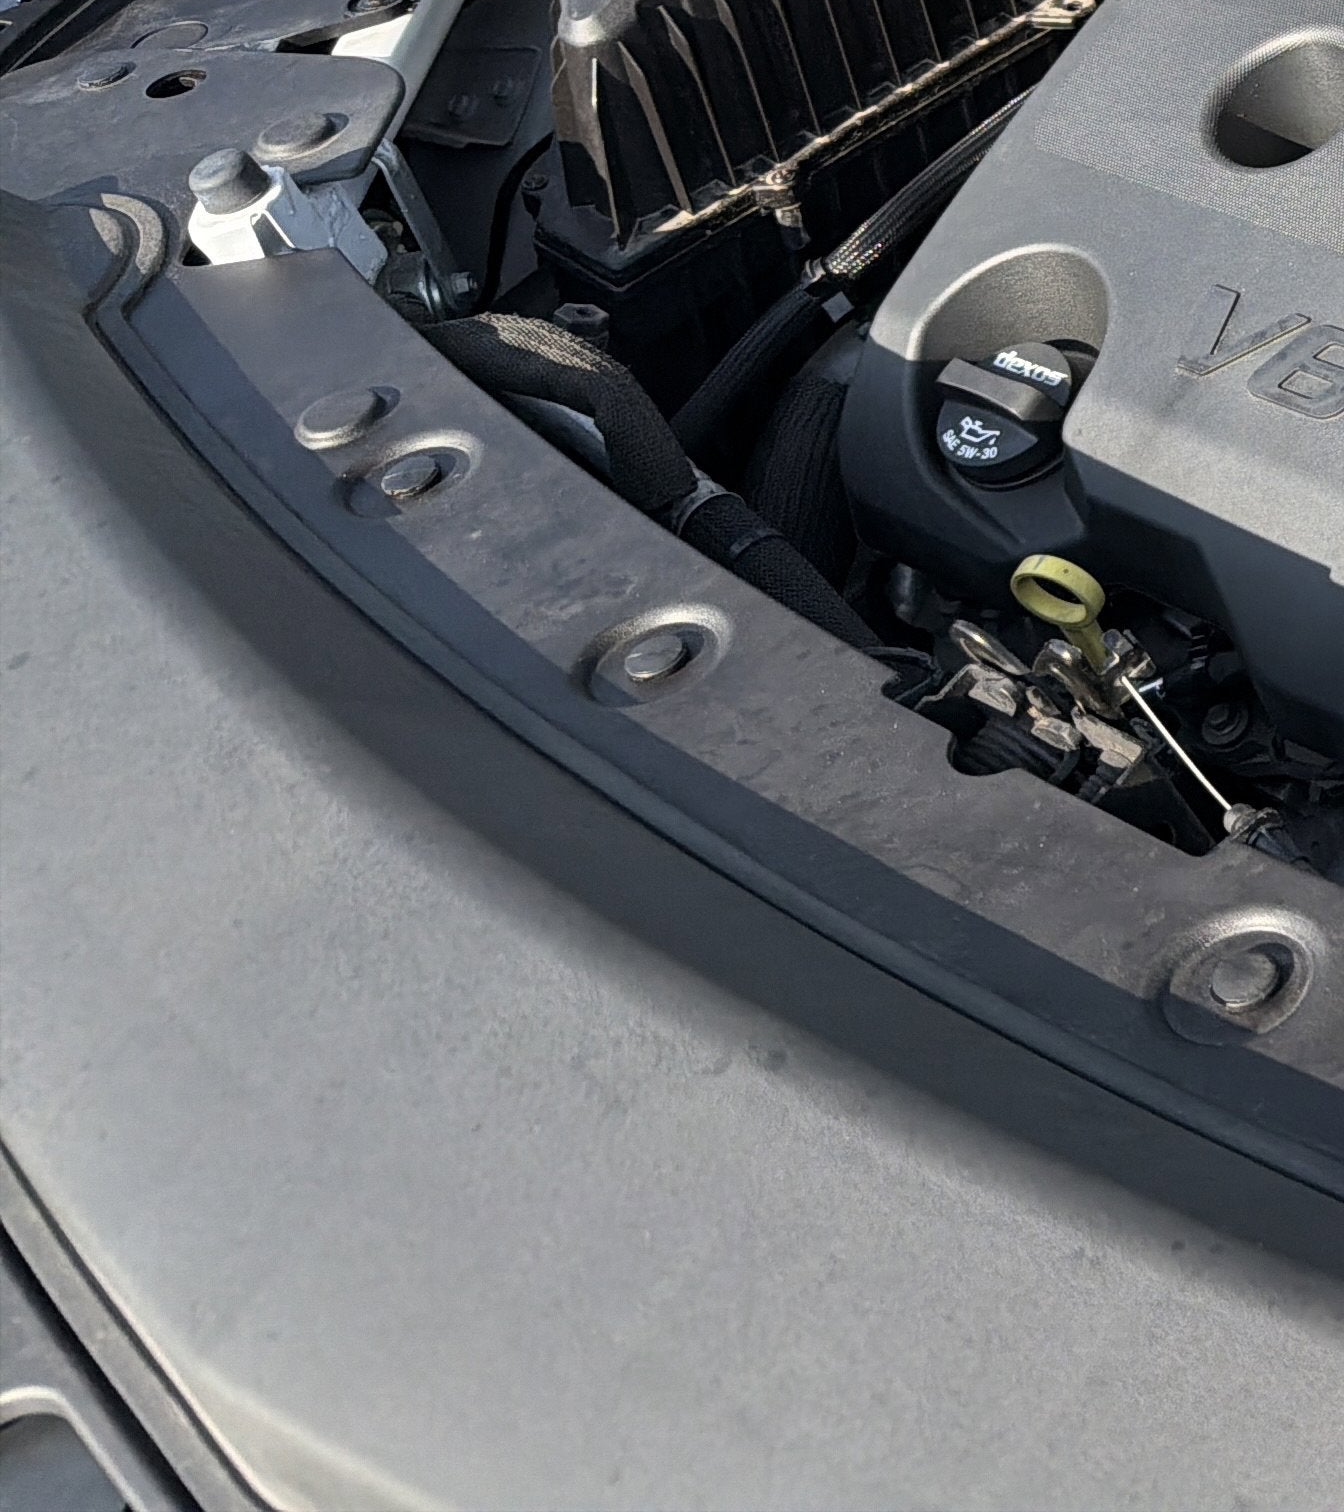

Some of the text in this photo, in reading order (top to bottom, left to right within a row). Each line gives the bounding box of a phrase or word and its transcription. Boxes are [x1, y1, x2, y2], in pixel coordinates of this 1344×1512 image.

[993, 350, 1068, 387] dexos
[942, 429, 998, 460] SAE 5W-30
